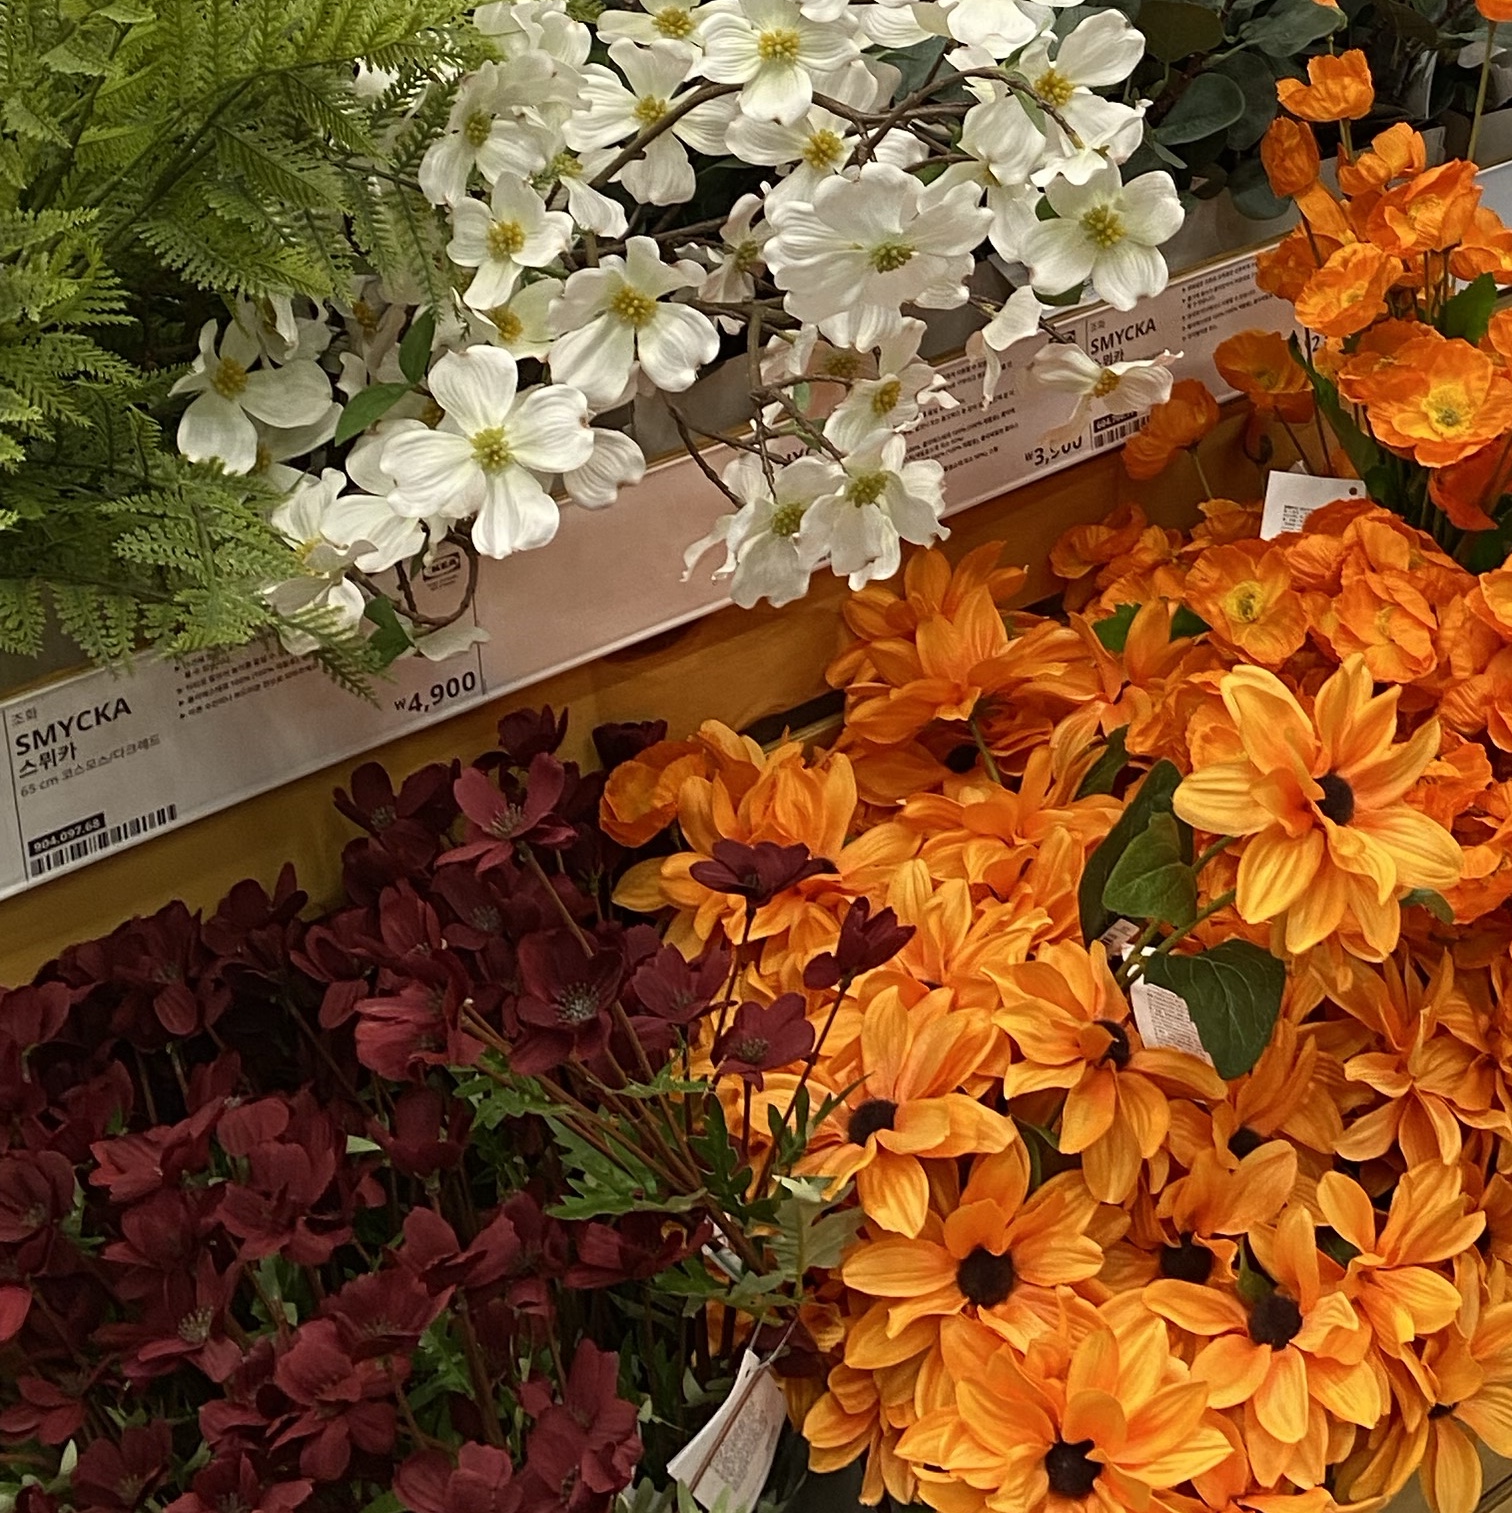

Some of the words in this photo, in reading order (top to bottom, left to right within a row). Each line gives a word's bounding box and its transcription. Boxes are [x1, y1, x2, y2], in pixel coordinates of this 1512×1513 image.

[1091, 318, 1156, 355] SMYCKA
[15, 697, 132, 756] SMYCKA
[19, 742, 78, 779] 스뮈카
[39, 776, 59, 790] cm
